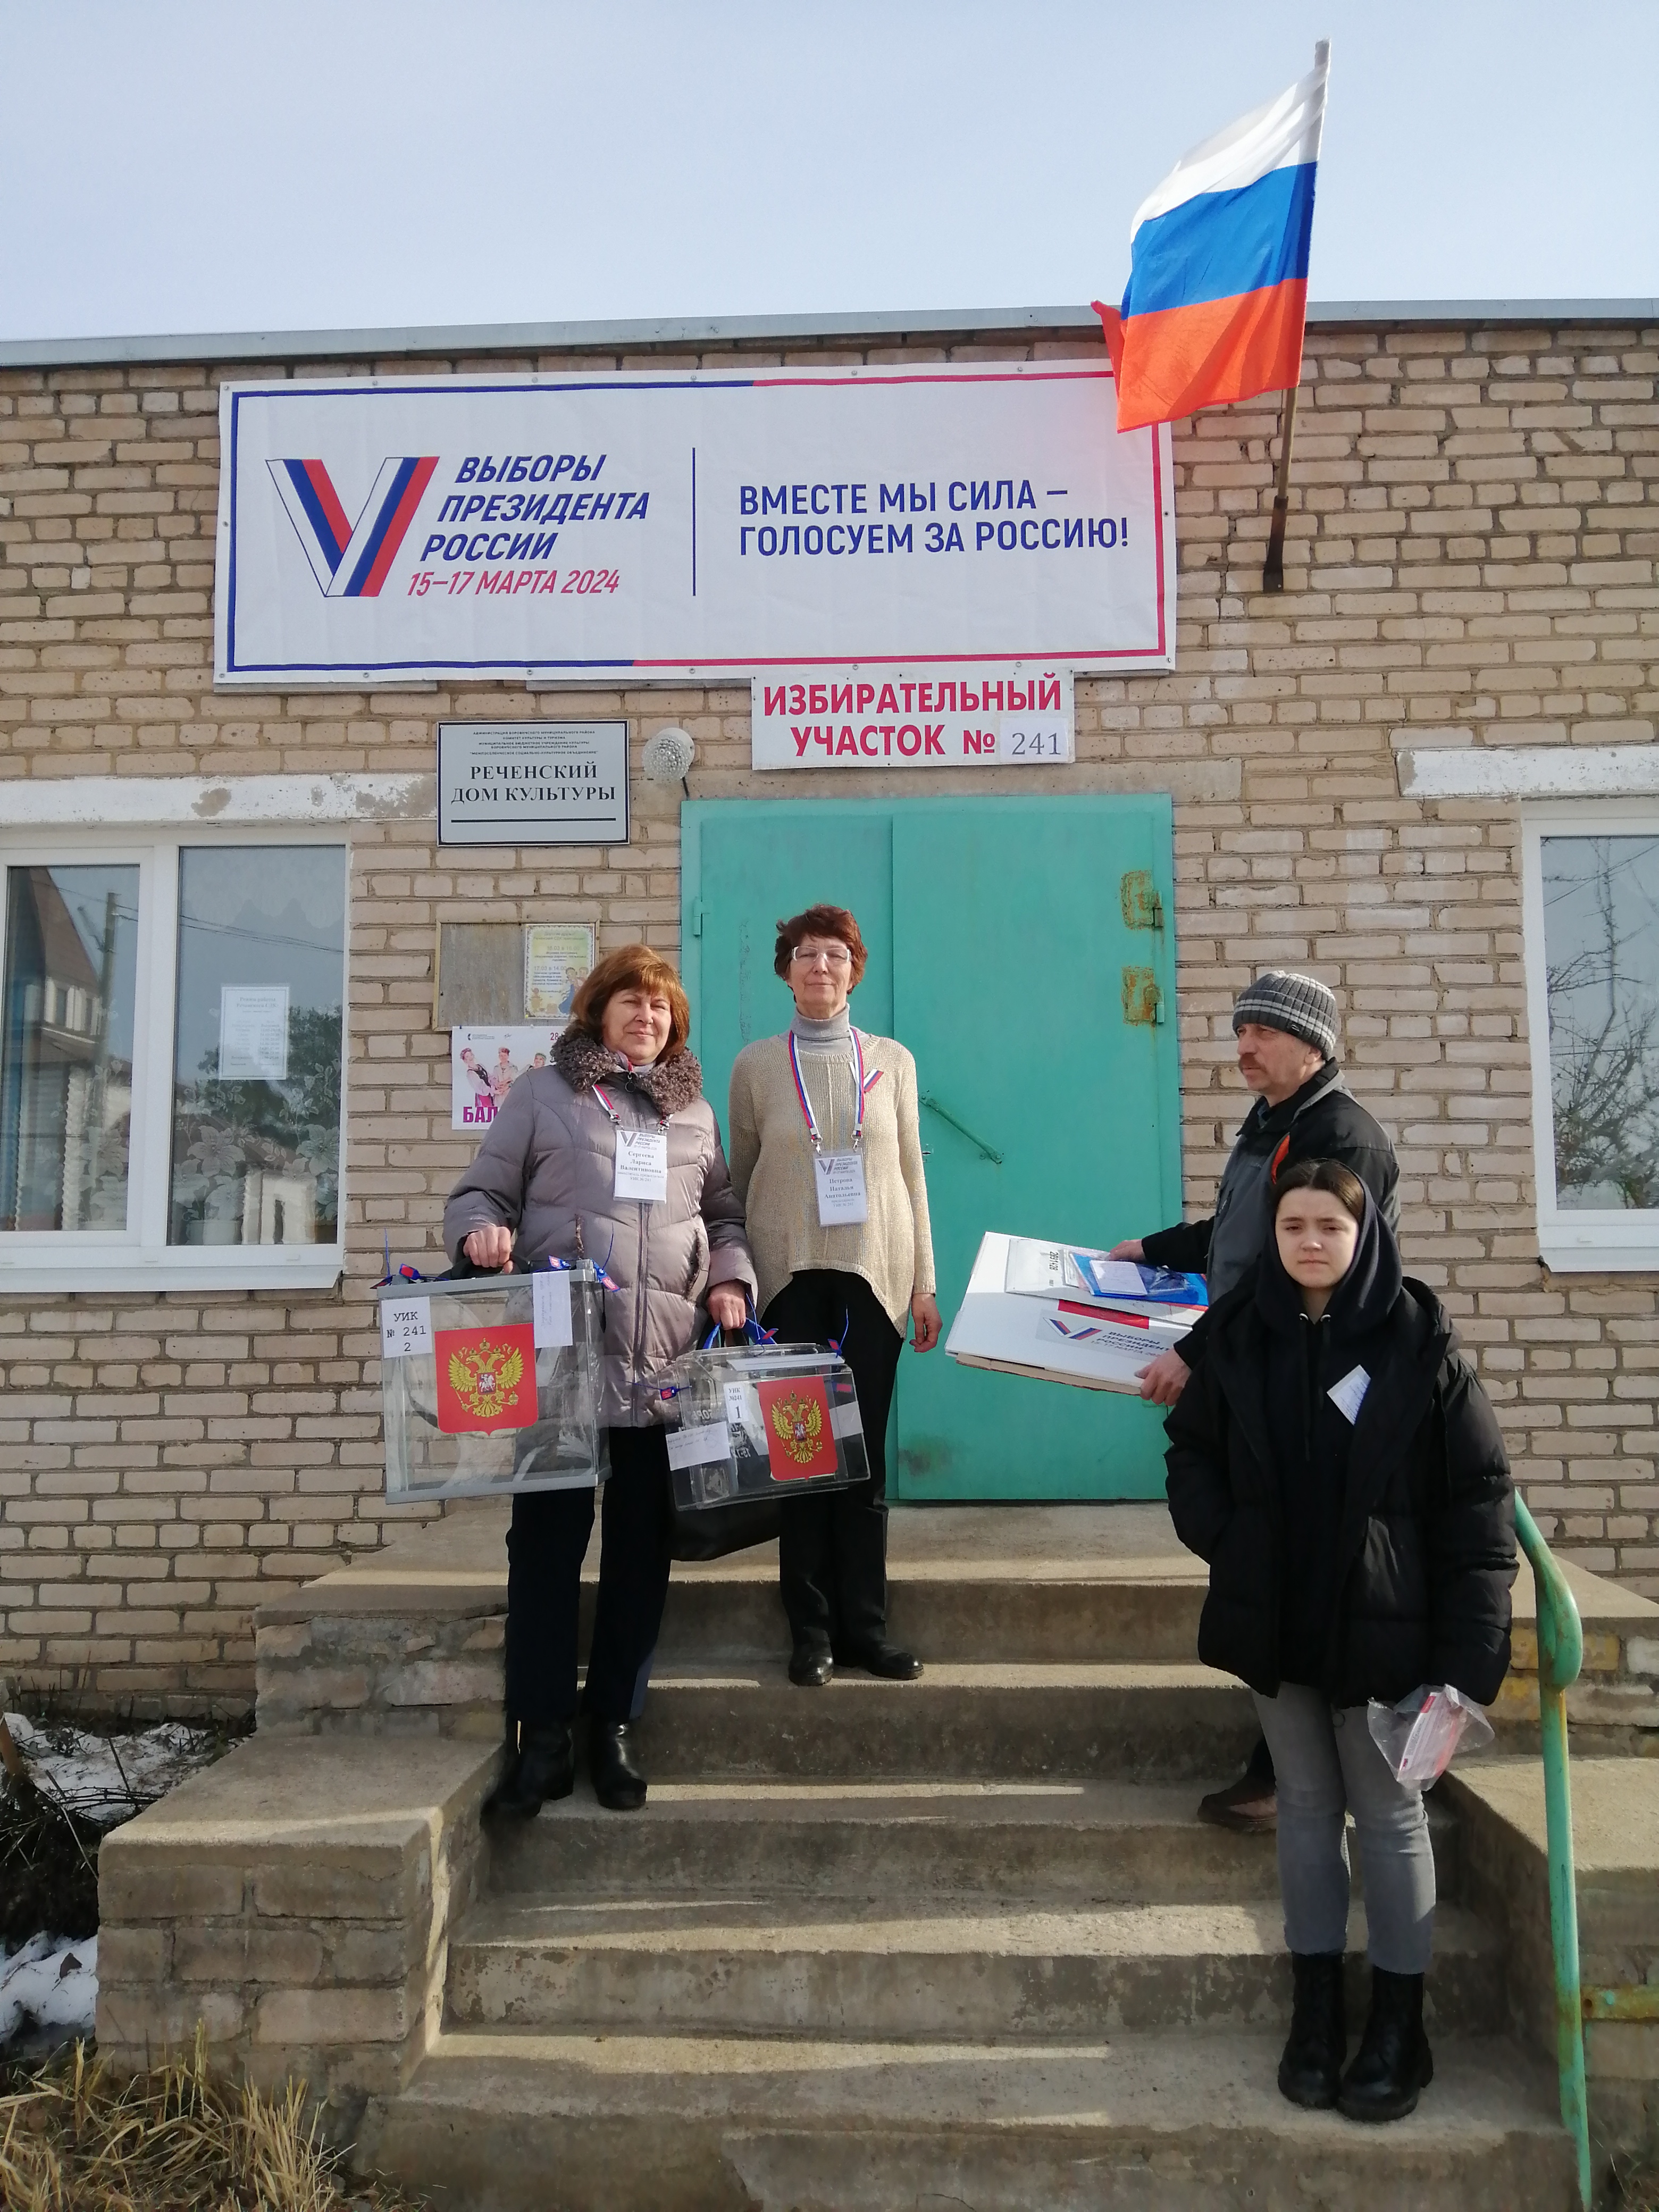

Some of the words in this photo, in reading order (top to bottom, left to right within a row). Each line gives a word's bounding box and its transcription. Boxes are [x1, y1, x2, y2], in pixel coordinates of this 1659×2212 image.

[455, 454, 607, 484] ВЫБОРЫ
[739, 483, 868, 515] ВМЕСТЕ
[879, 481, 936, 514] МЫ
[948, 479, 1036, 512] СИЛА
[437, 491, 650, 526] ПРЕЗИДЕНТА
[740, 521, 914, 556] ГОЛОСУЕМ
[924, 521, 965, 552] ЗА
[975, 516, 1129, 551] РОССИЮ!
[420, 532, 558, 562] РОССИИ
[475, 570, 557, 596] МАРТА
[560, 568, 620, 594] 2024
[764, 672, 1062, 717] ИЗБИРАТЕЛЬНЫЙ
[790, 724, 946, 758] УЧАСТОК
[962, 729, 996, 755] №
[1011, 732, 1061, 756] 241
[470, 760, 598, 780] РЕЧЕНСКИЙ
[450, 787, 498, 805] ДОМ
[505, 786, 616, 802] КУЛЬТУРЫ
[550, 1032, 558, 1041] 28
[393, 1311, 418, 1322] УИК
[387, 1329, 395, 1338] №
[403, 1326, 426, 1337] 241
[1108, 1331, 1161, 1345] ВЫБОРЫ
[404, 1342, 411, 1352] 2
[1096, 1338, 1143, 1350] РОССИИ
[1102, 1335, 1170, 1351] ПРЕЗИДЕНТ
[735, 1406, 741, 1419] 1
